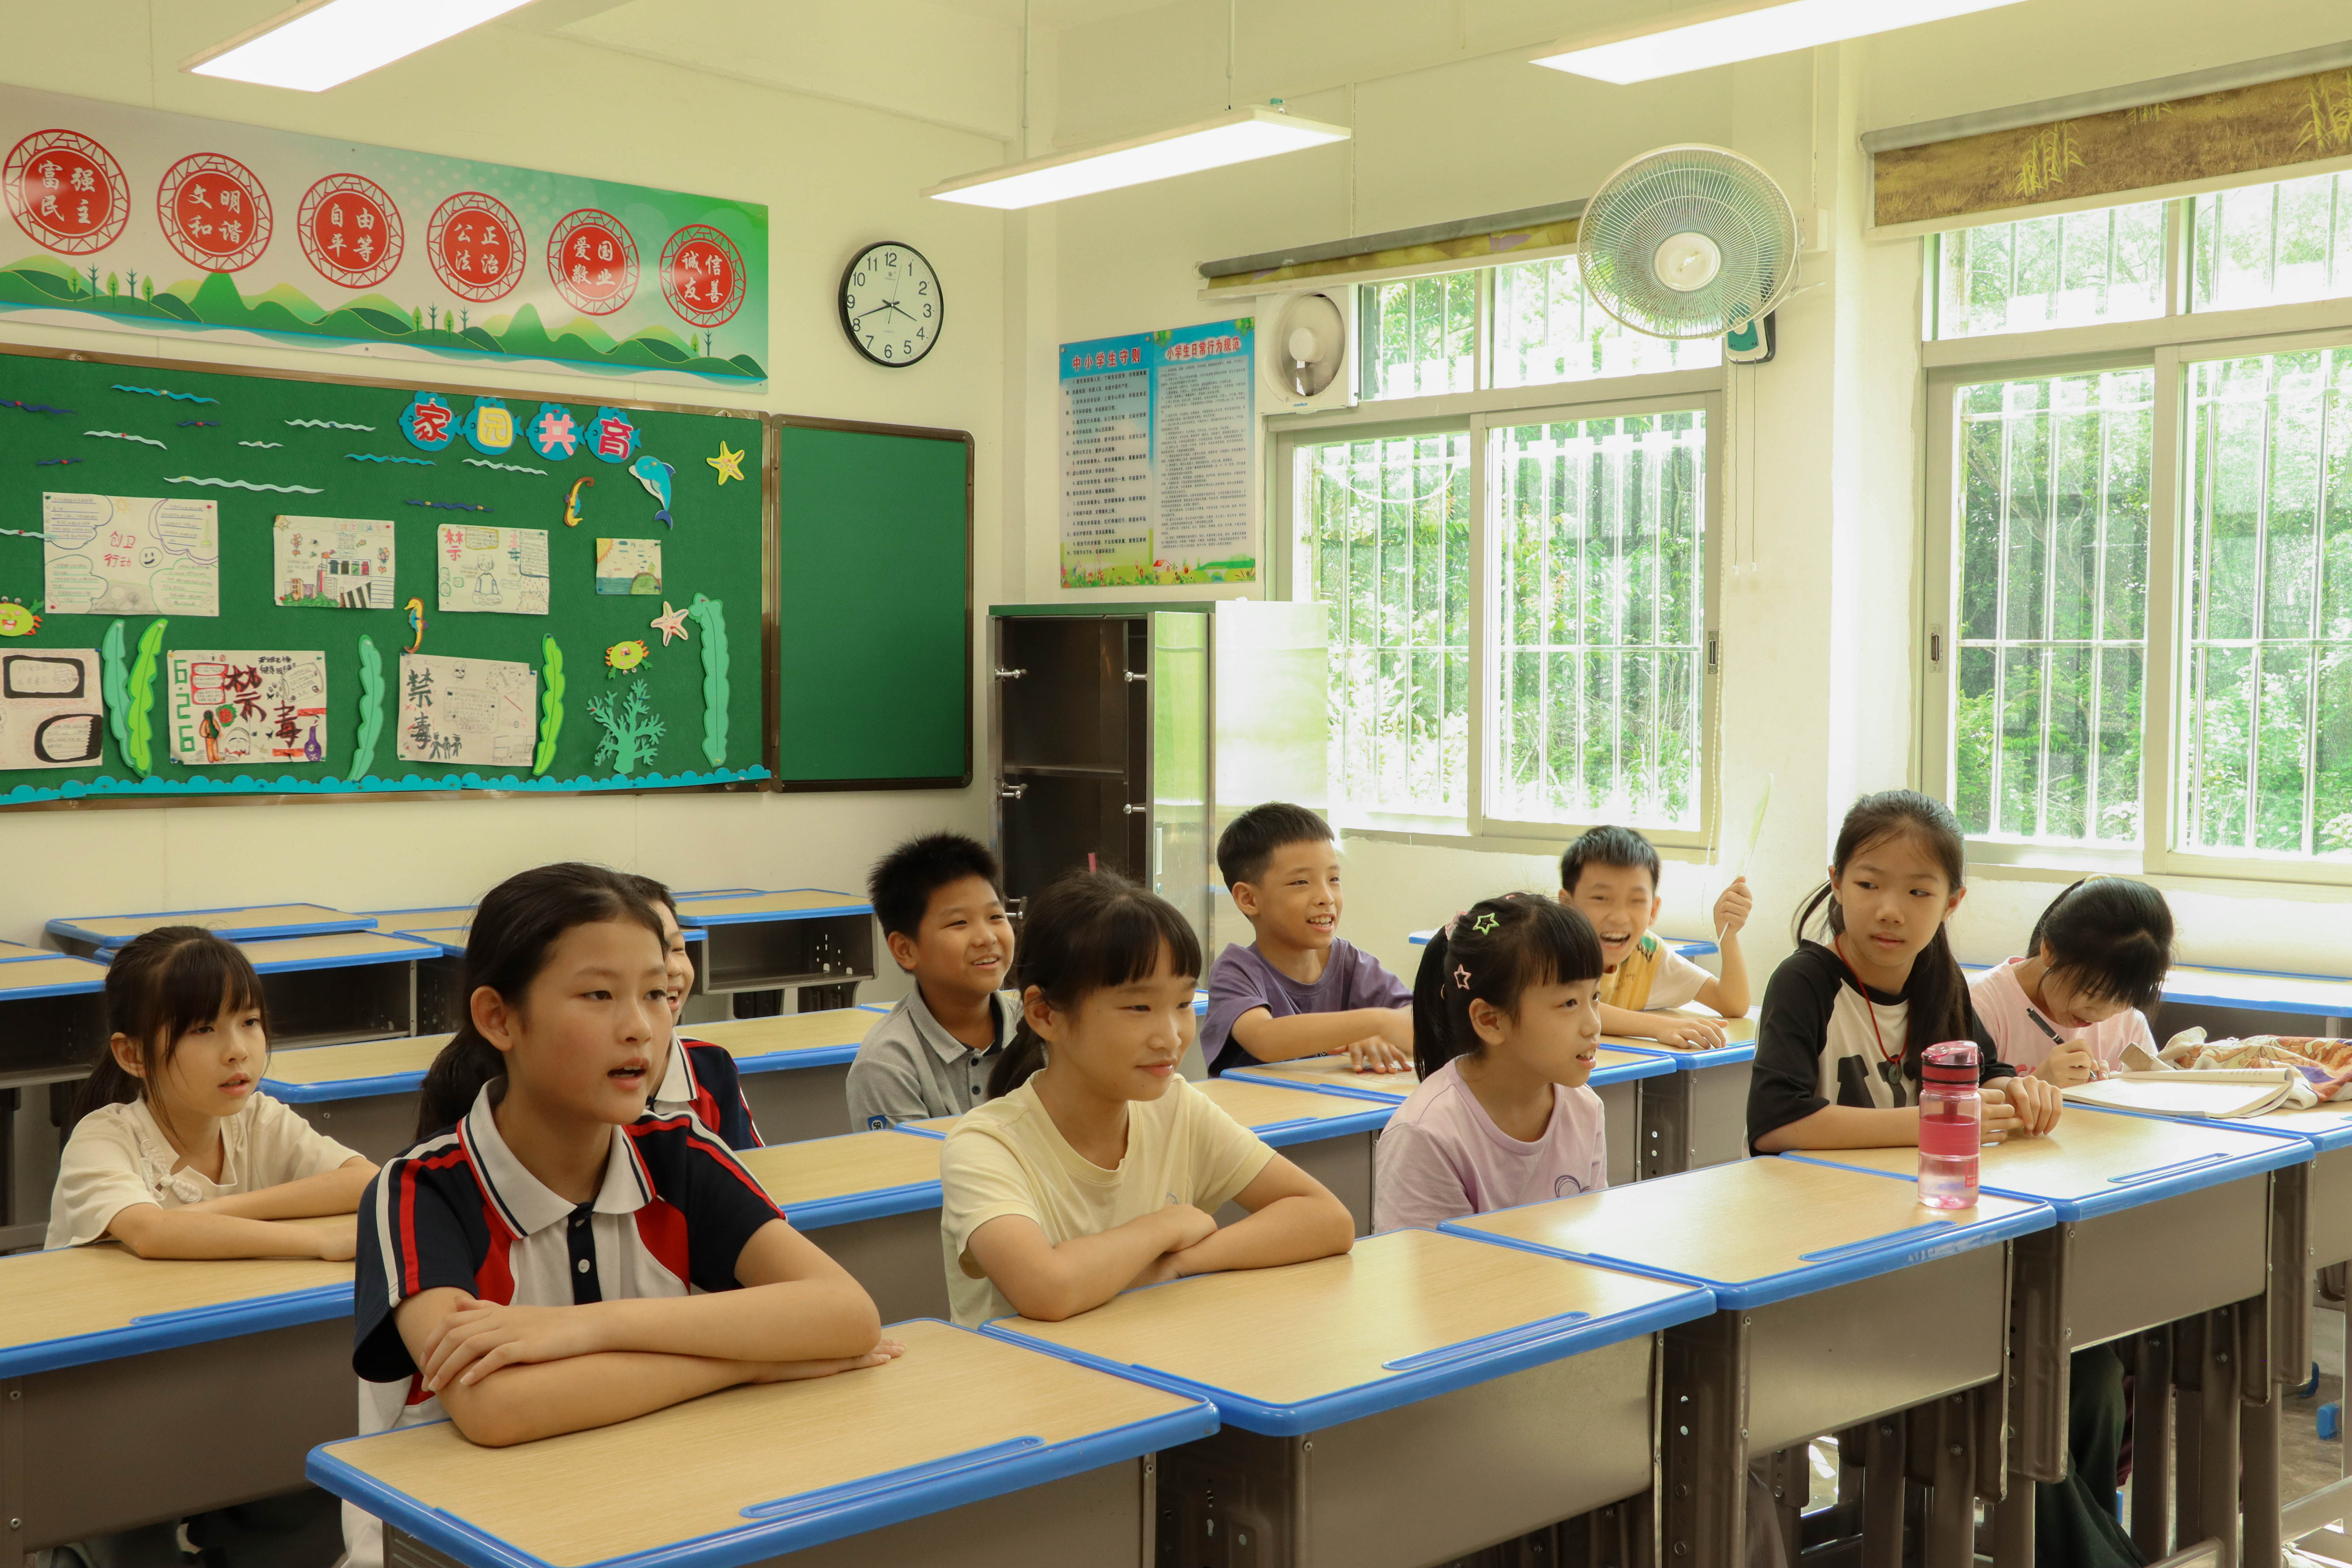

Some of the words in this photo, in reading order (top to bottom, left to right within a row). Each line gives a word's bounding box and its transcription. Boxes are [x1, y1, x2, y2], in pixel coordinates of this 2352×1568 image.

[38, 160, 95, 193] 富强
[41, 196, 92, 224] 民主
[188, 184, 241, 215] 文明
[331, 203, 376, 231] 自由
[187, 216, 243, 244] 和谐
[454, 223, 500, 246] 公正
[327, 234, 375, 262] 平等
[573, 237, 613, 261] 爱国
[885, 252, 897, 267] 12
[455, 251, 499, 274] 法治
[682, 250, 723, 276] 诚信
[867, 257, 877, 271] 11
[908, 262, 912, 276] 1
[572, 263, 616, 286] 敬业
[853, 272, 865, 287] 10
[683, 278, 723, 303] 友善
[918, 281, 927, 295] 2
[847, 294, 855, 309] 9
[923, 303, 932, 318] 3
[852, 318, 861, 332] 8
[916, 326, 925, 340] 4
[866, 335, 874, 349] 7
[884, 344, 892, 358] 6
[904, 340, 911, 354] 5
[1167, 336, 1240, 360] 小学生日常行为规范
[1073, 347, 1141, 371] 中小学生守则
[413, 404, 632, 459] 家园共育
[110, 530, 136, 548] 创卫
[103, 553, 131, 568] 行动
[406, 668, 434, 750] 禁毒
